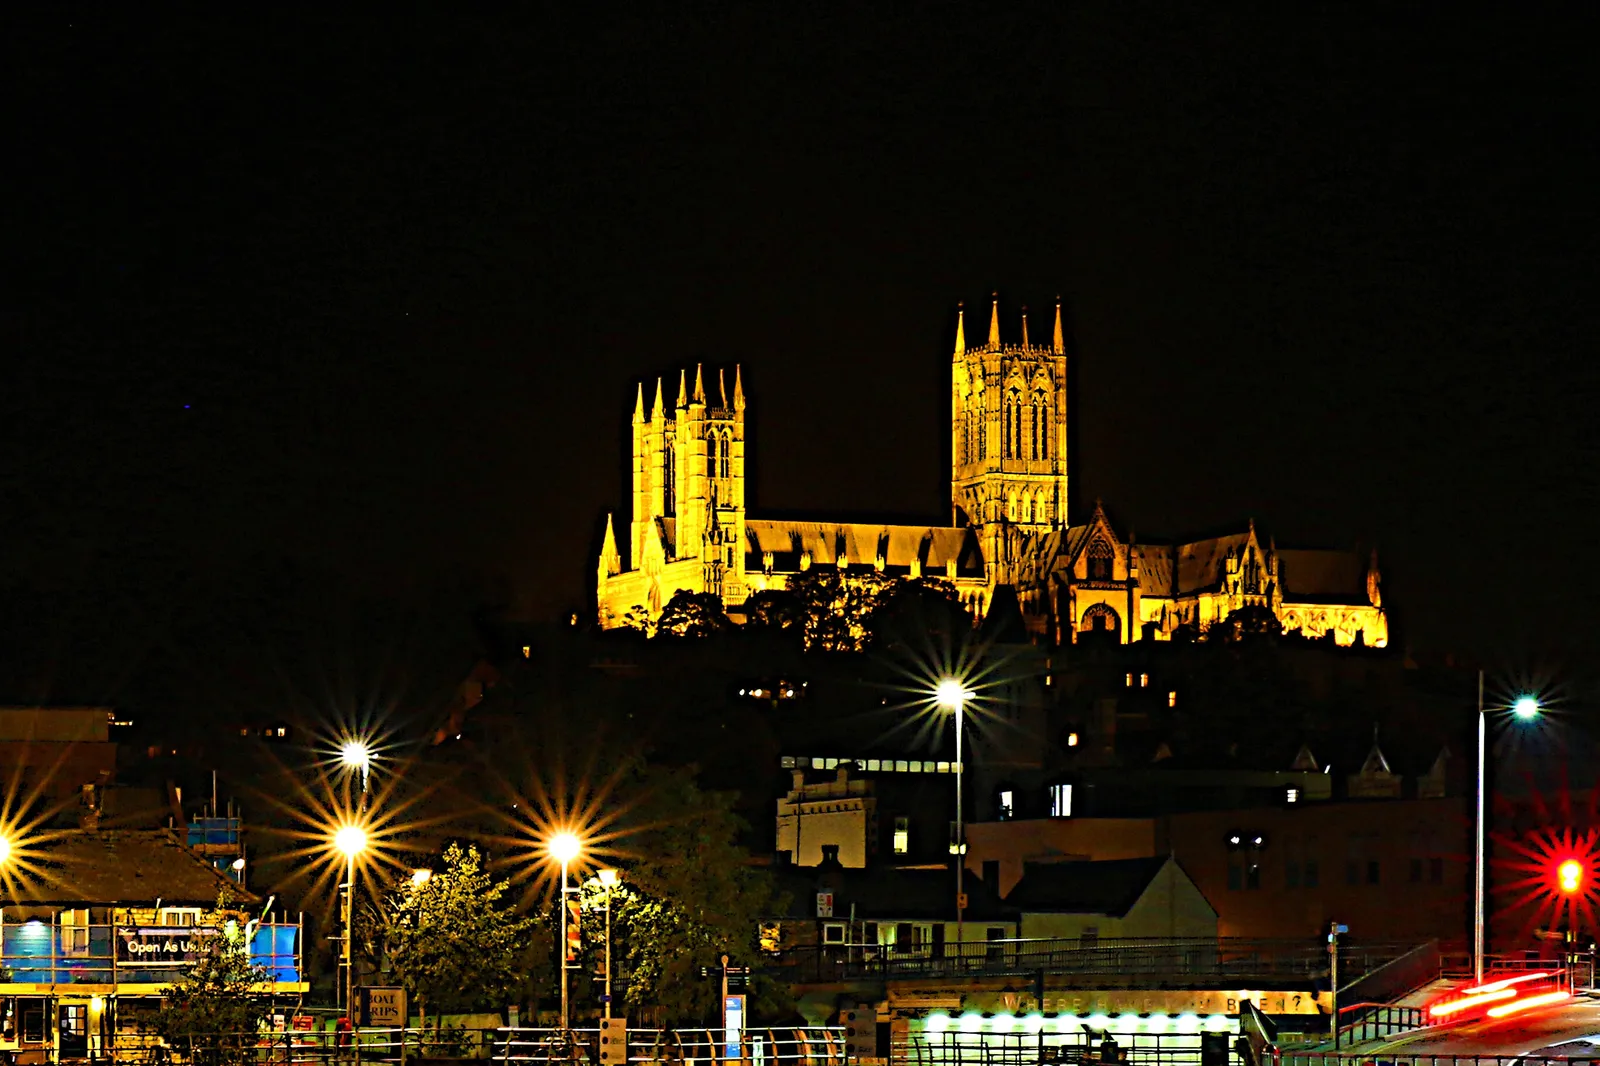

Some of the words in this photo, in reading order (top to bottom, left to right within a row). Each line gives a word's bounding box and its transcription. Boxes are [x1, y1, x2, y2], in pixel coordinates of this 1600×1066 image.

[127, 940, 160, 956] Open
[163, 940, 178, 953] As
[180, 940, 211, 953] Usa
[370, 1006, 398, 1016] RIPS
[1226, 995, 1302, 1012] BEN?
